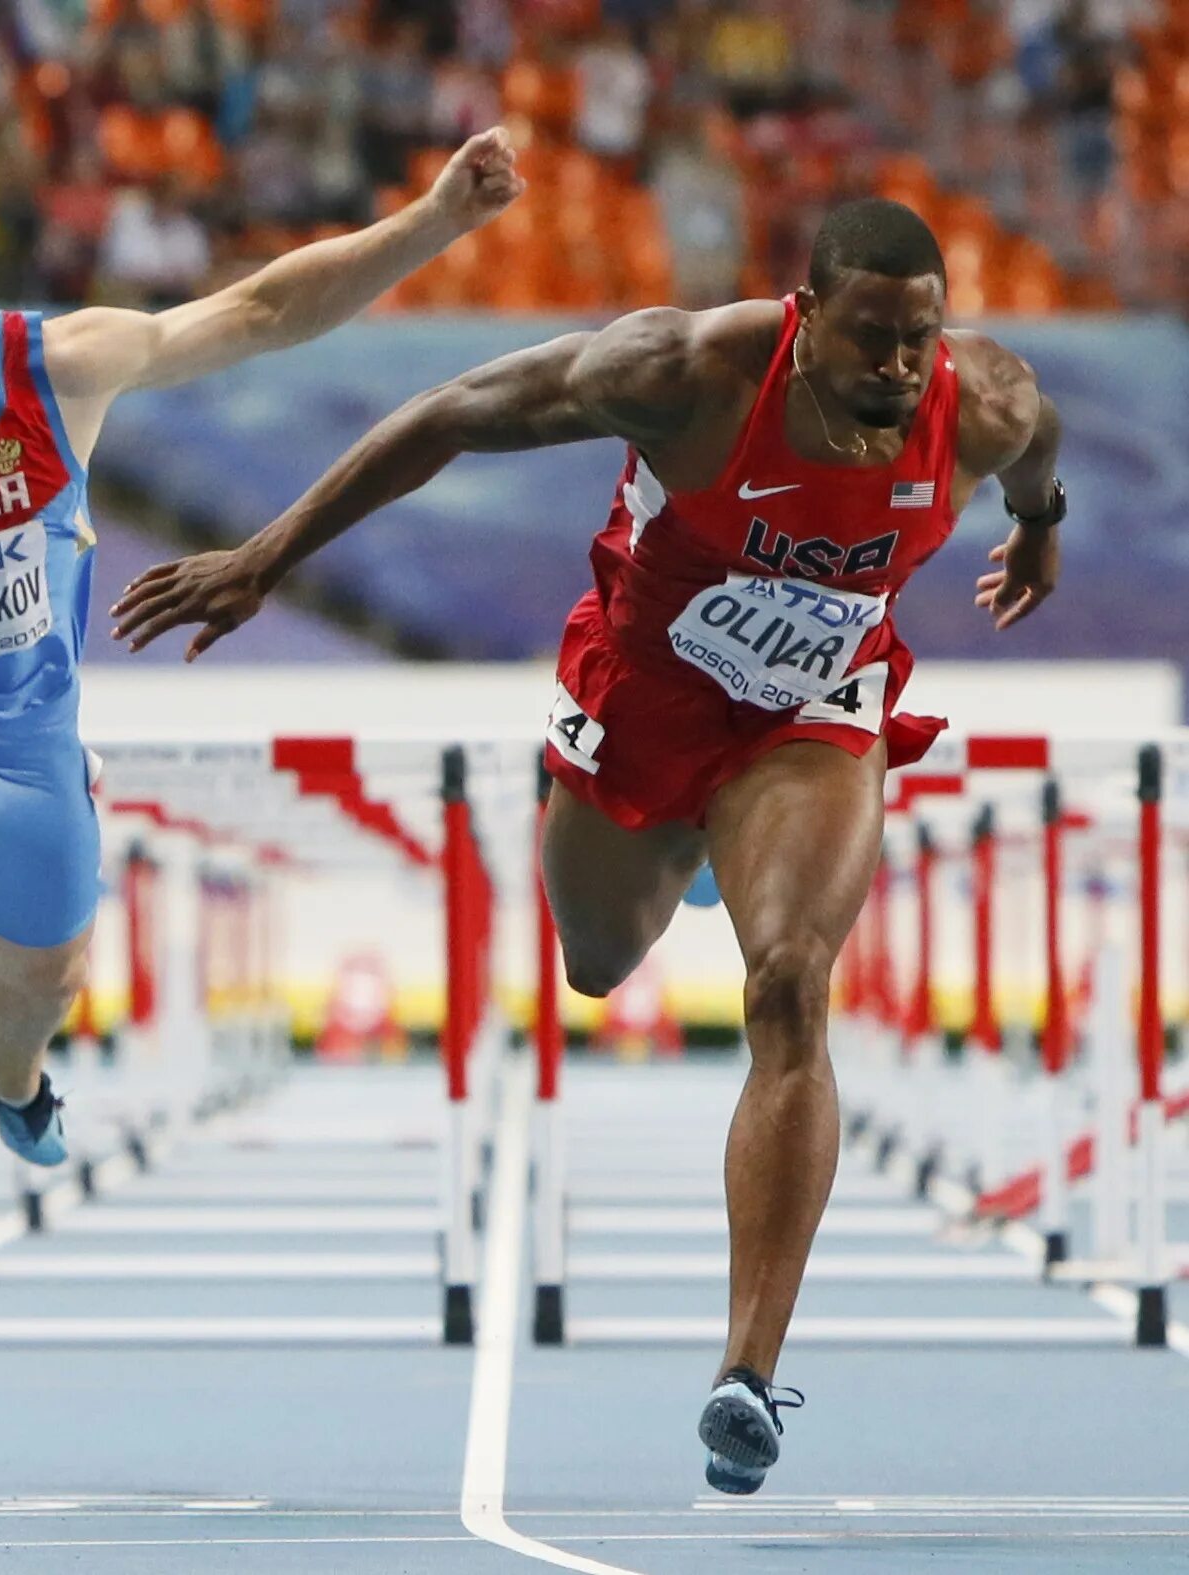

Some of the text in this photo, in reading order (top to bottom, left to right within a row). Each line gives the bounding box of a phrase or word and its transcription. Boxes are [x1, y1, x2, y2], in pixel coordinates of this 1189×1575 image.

[741, 516, 900, 578] USA
[781, 582, 879, 628] TDK
[671, 632, 750, 696] MOSCO
[822, 678, 862, 714] 4
